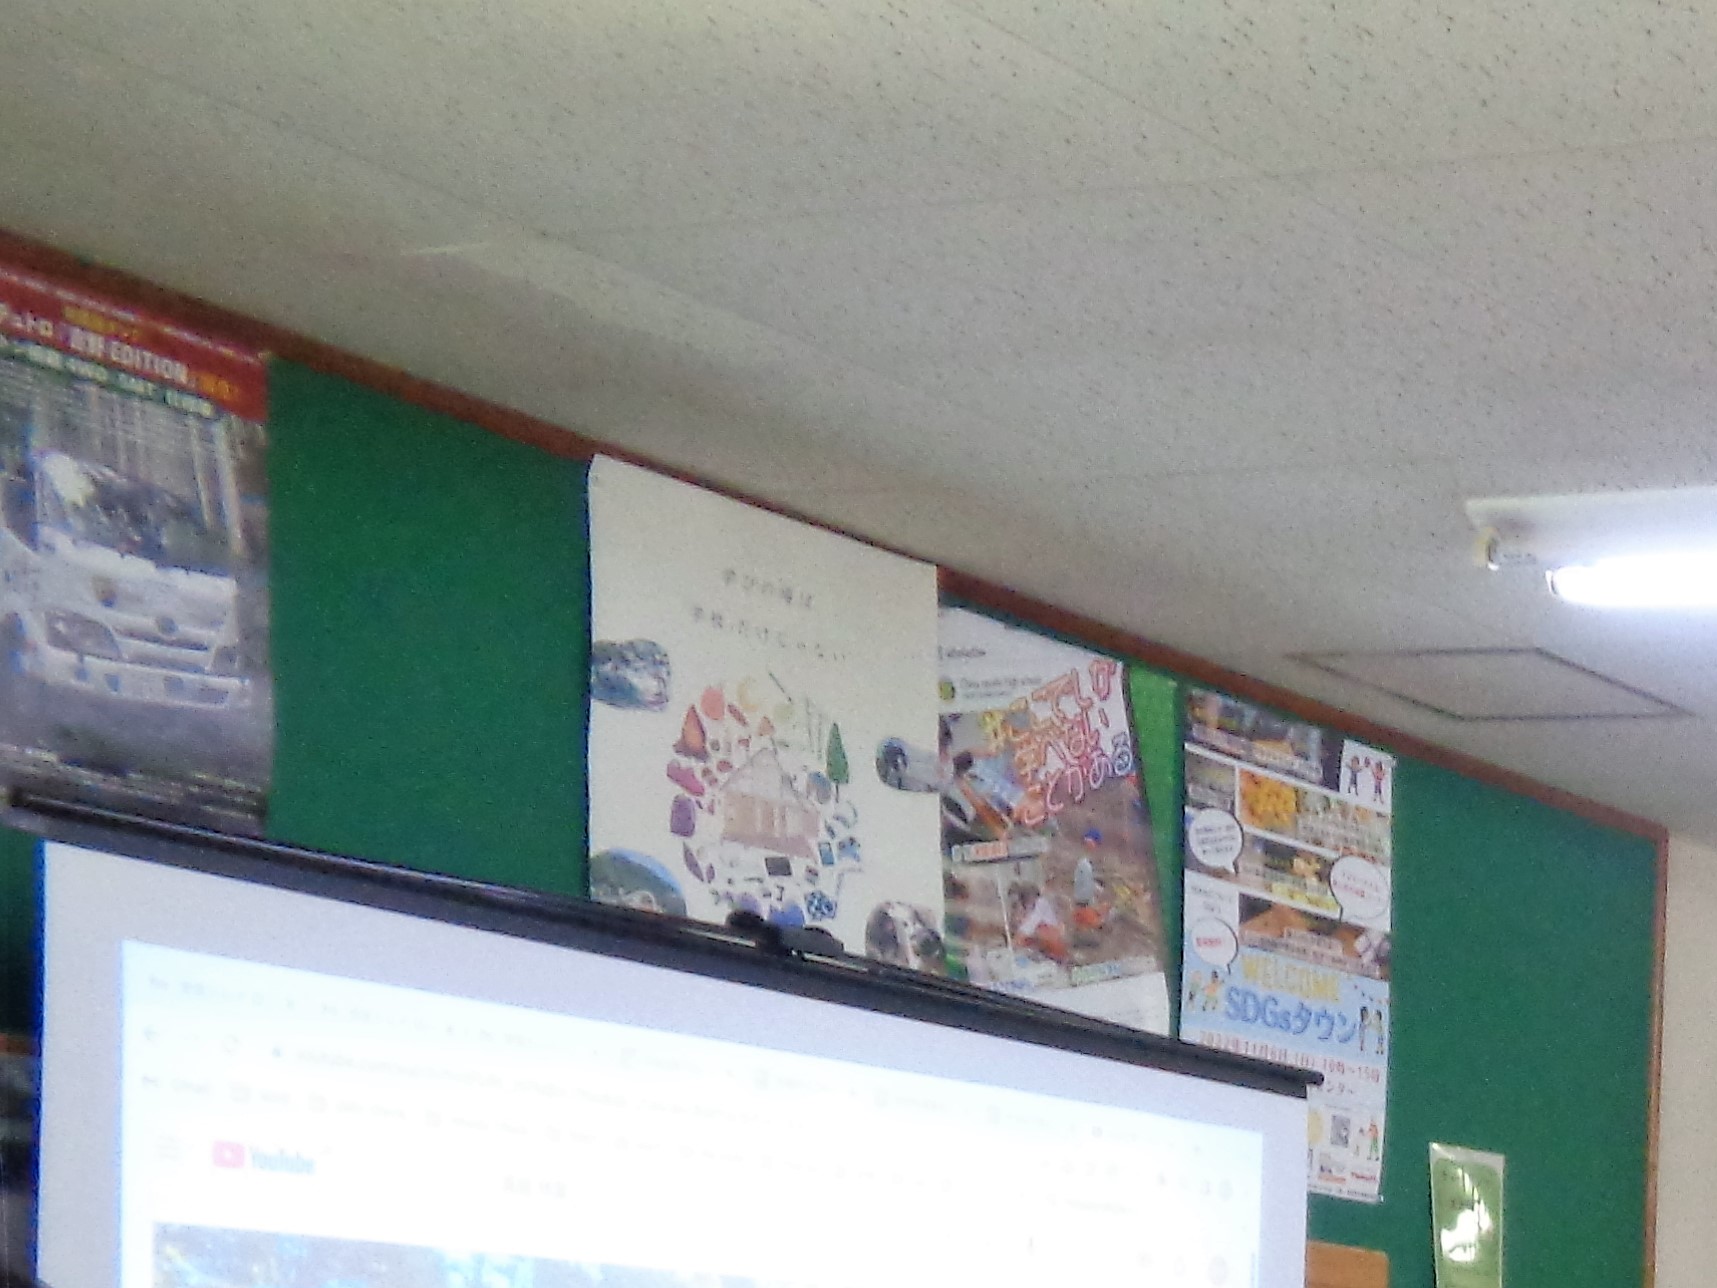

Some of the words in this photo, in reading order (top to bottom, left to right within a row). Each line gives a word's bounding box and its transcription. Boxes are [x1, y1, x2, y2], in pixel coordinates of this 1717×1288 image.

[1241, 953, 1341, 1003] WELCOME
[1224, 984, 1357, 1044] SDGsタウン
[250, 1145, 316, 1176] YouTube
